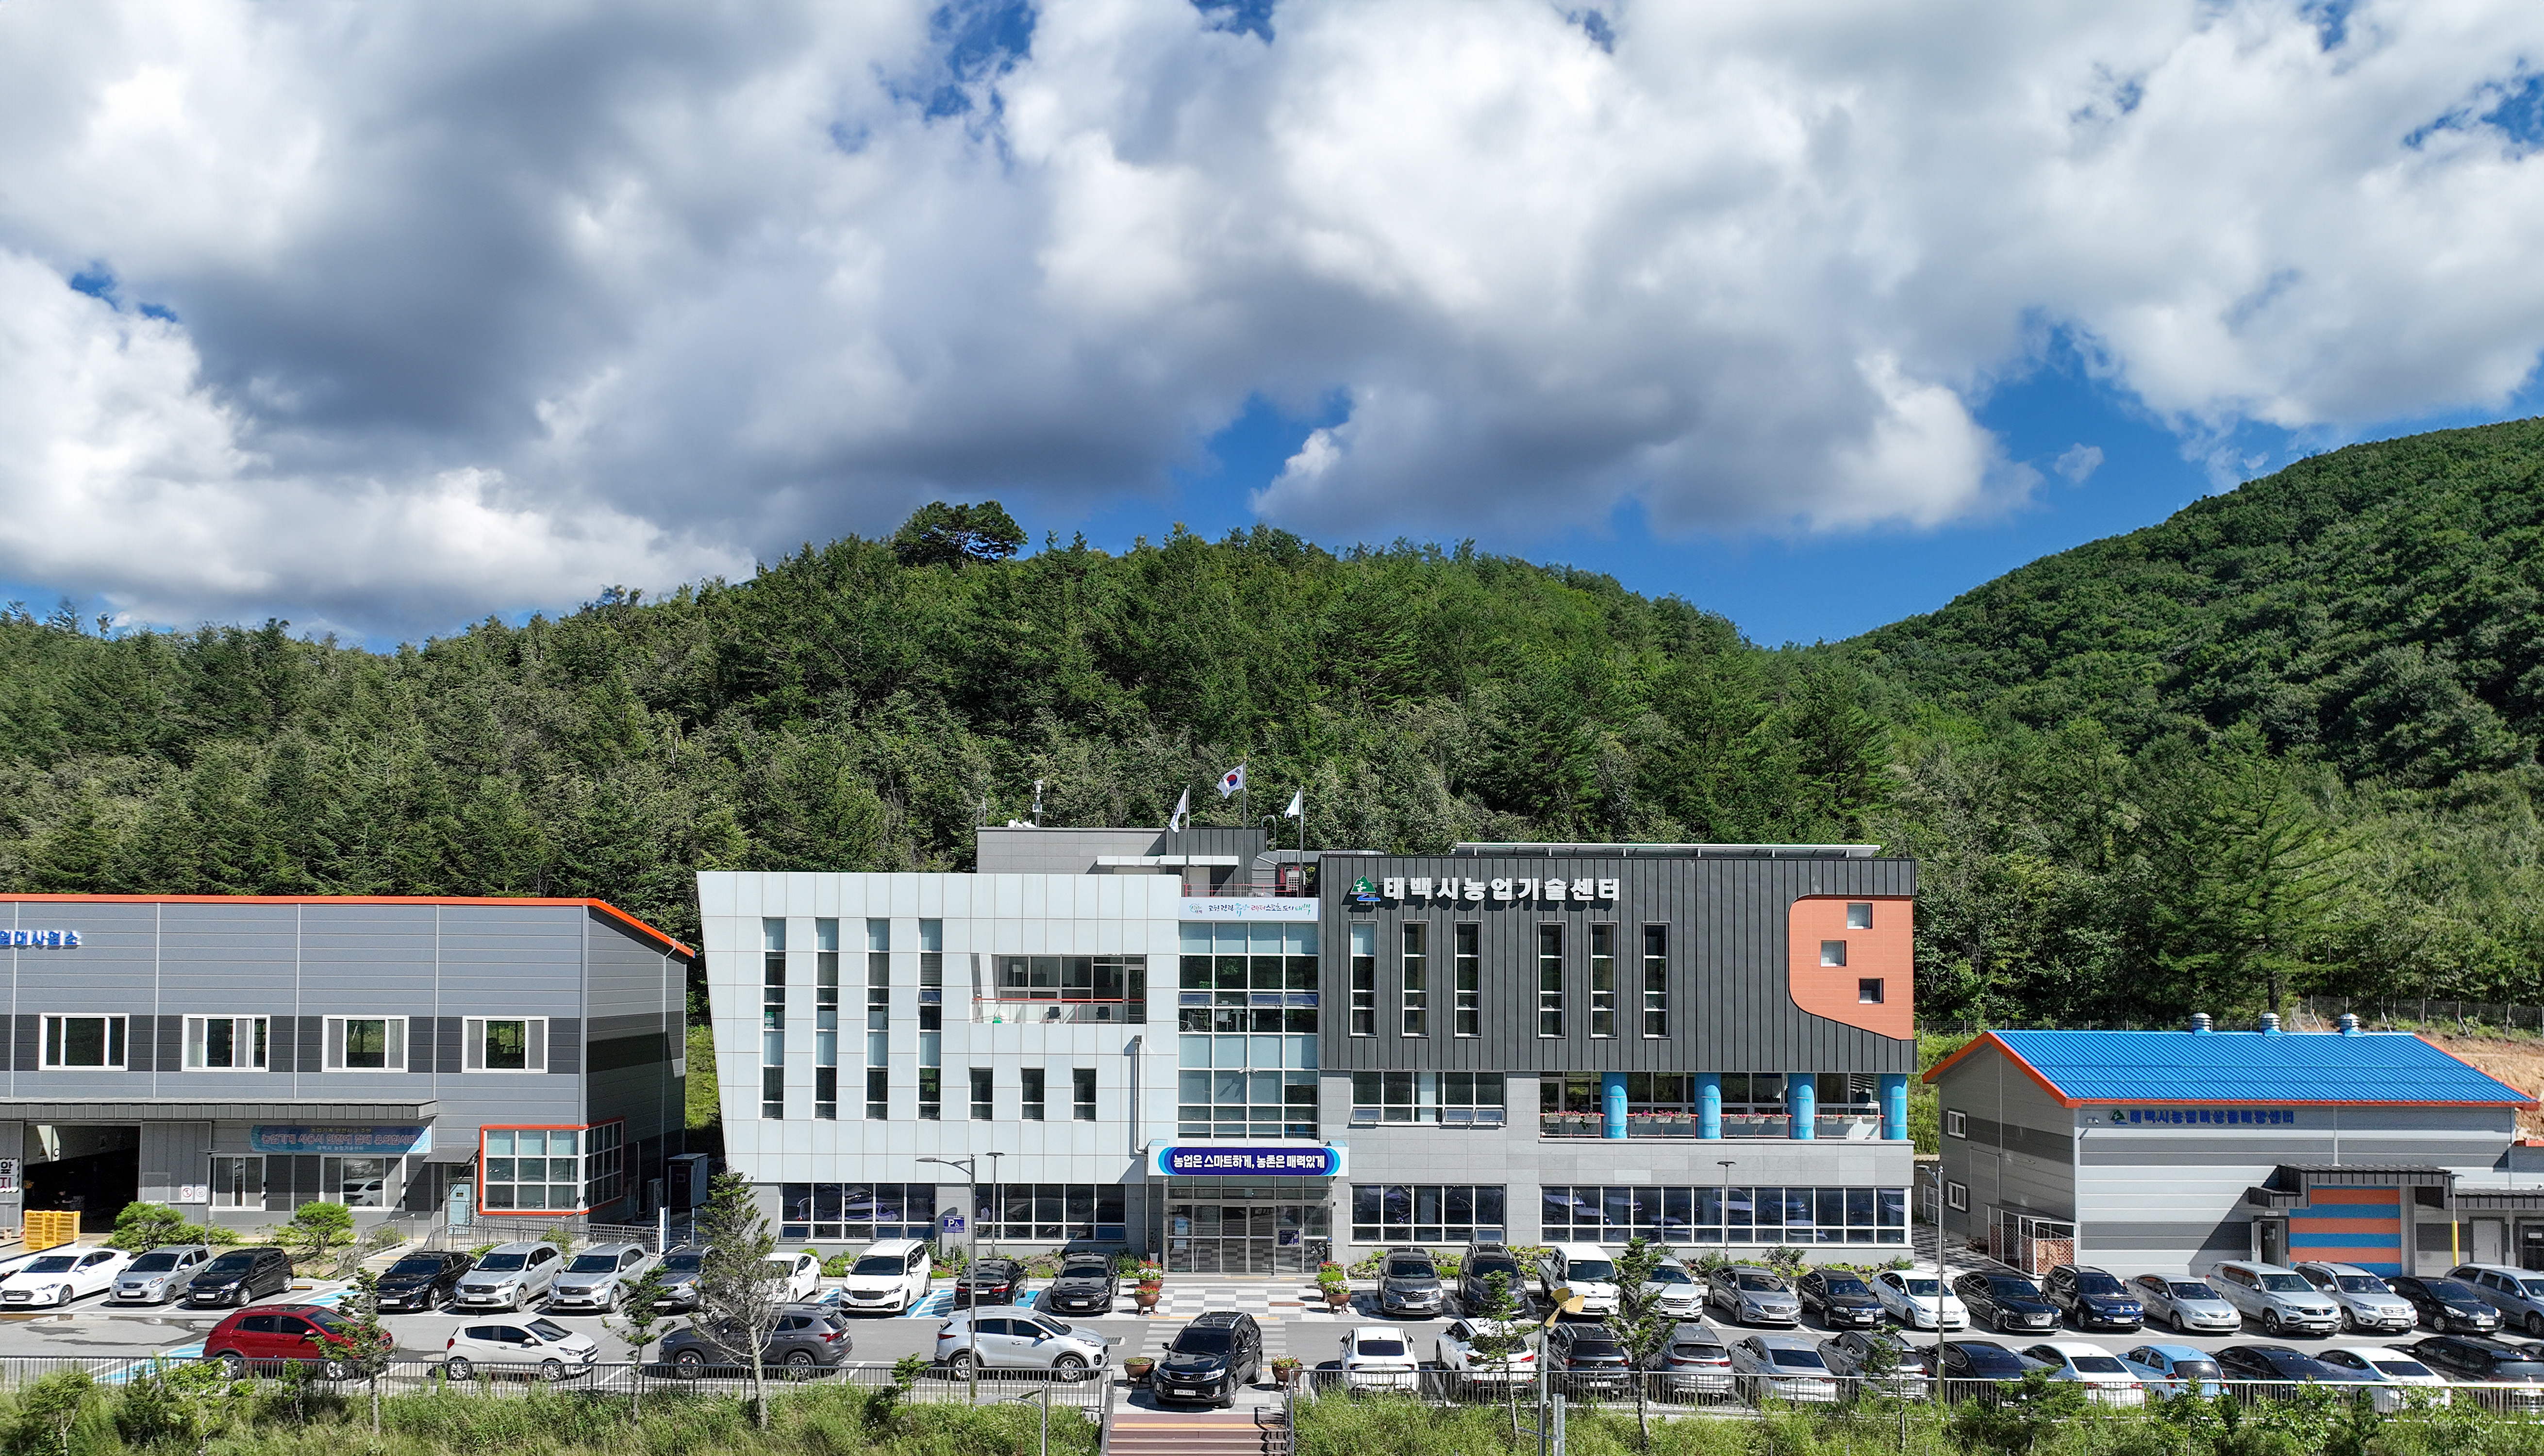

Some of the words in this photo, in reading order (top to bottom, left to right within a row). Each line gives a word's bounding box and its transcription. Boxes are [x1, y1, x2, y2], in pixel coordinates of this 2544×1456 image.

[1383, 877, 1619, 901] 태백시농업기술센터
[262, 1134, 296, 1144] 농업기계
[298, 1134, 324, 1144] 사용시
[327, 1134, 352, 1144] 안전에
[355, 1135, 372, 1145] 절대
[0, 1161, 13, 1174] 앞
[1174, 1155, 1202, 1168] 농업은
[1204, 1155, 1254, 1169] 스마트하게,
[1257, 1155, 1285, 1168] 농촌은
[1287, 1155, 1325, 1168] 매력있게
[0, 1177, 11, 1189] 지
[948, 1219, 955, 1227] P
